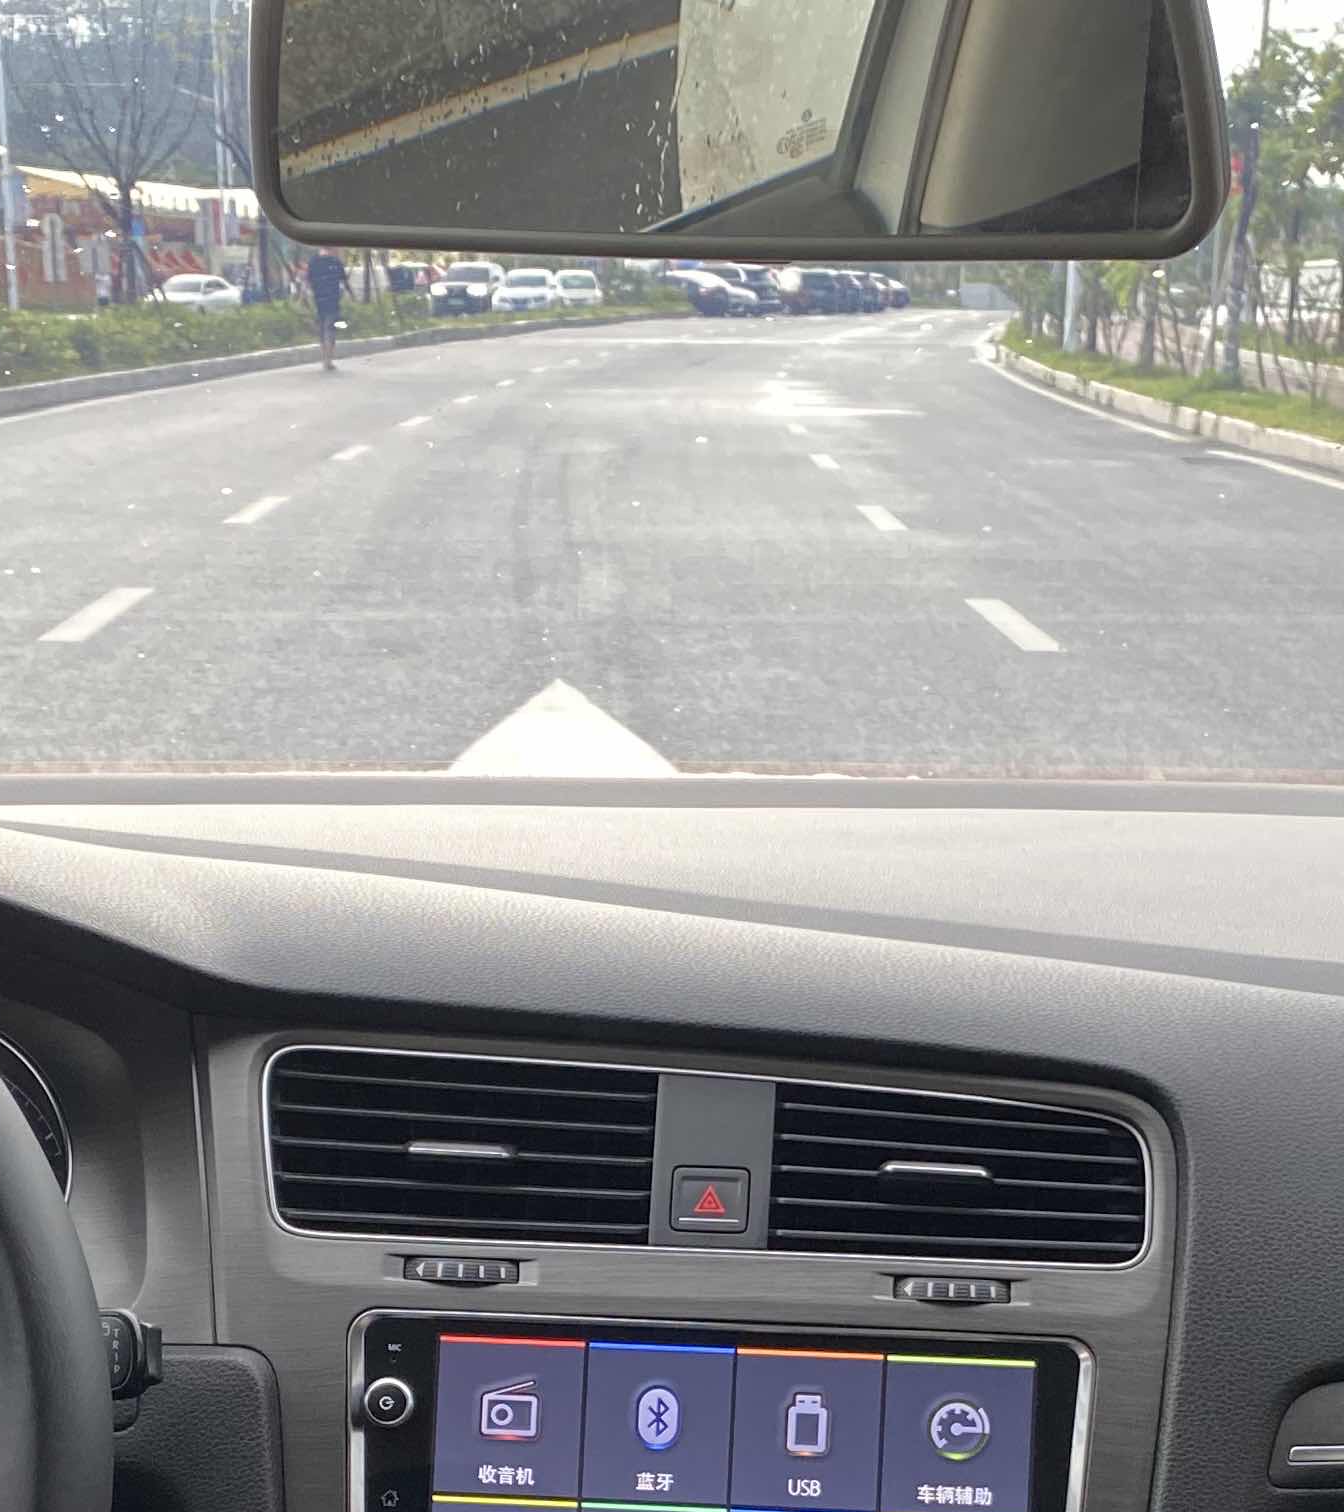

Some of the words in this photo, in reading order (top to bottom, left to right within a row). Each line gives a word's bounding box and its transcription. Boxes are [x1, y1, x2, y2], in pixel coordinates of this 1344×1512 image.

[112, 1328, 121, 1374] TRIP
[478, 1463, 536, 1486] 收音机
[635, 1471, 675, 1492] 蓝牙
[787, 1478, 821, 1497] USB
[916, 1484, 993, 1507] 车辆辅助
